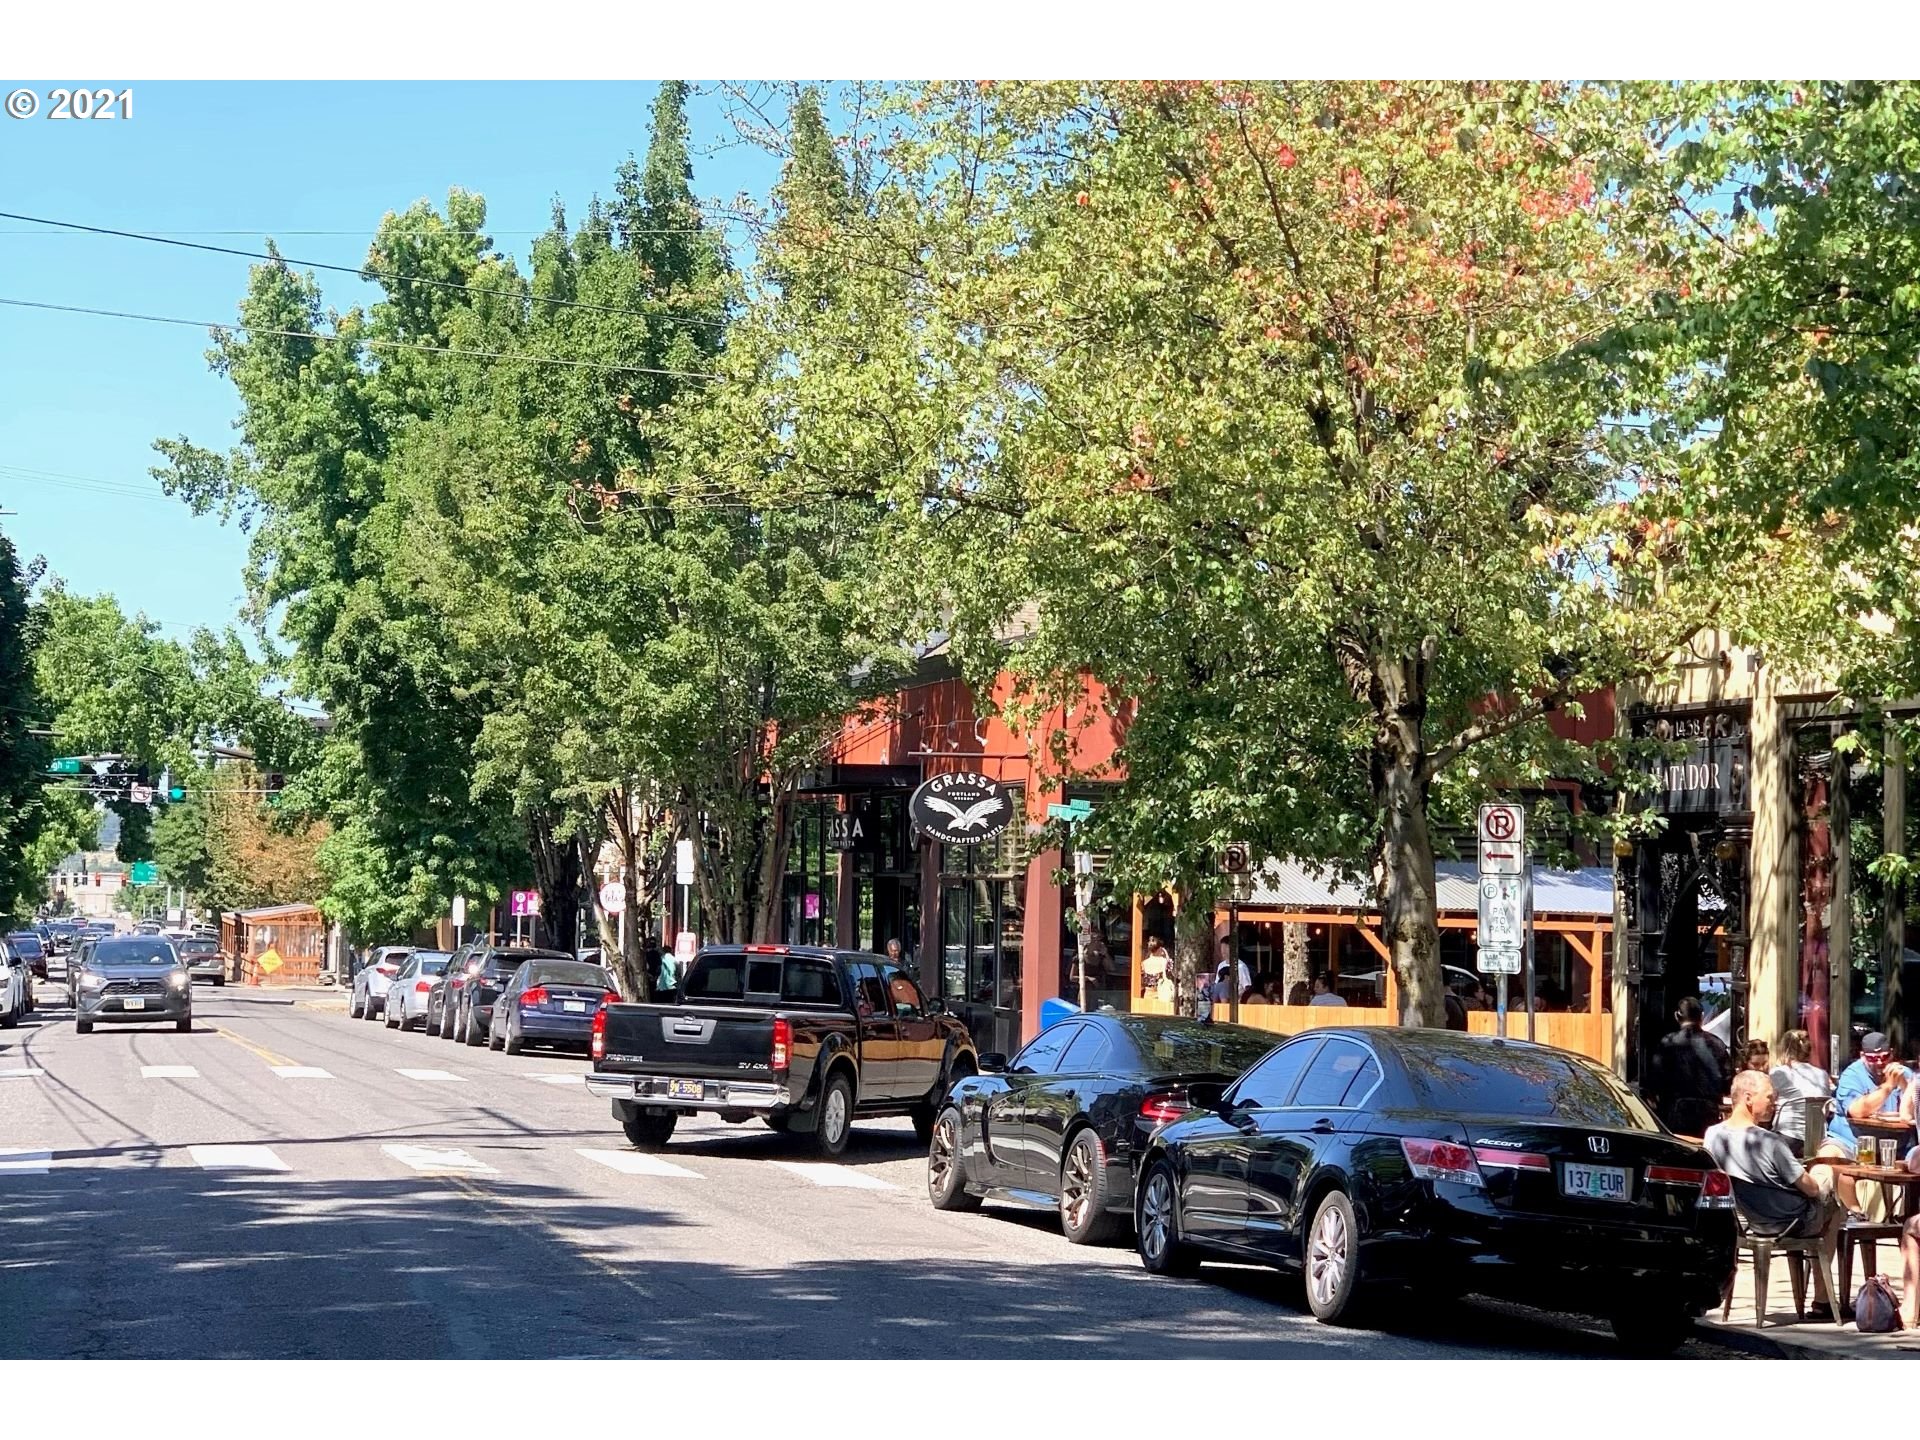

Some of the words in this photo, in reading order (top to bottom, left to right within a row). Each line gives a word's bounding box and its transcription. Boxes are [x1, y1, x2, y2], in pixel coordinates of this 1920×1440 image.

[931, 772, 997, 797] GRASSA
[925, 824, 981, 844] HANDCRAFTED
[982, 824, 1004, 841] PASTA
[1493, 906, 1509, 916] PAY
[1494, 916, 1506, 925] TO
[1489, 925, 1511, 934] PARK
[1476, 1138, 1523, 1148] Accord
[1569, 1170, 1592, 1189] 137
[1600, 1172, 1624, 1193] EUR
